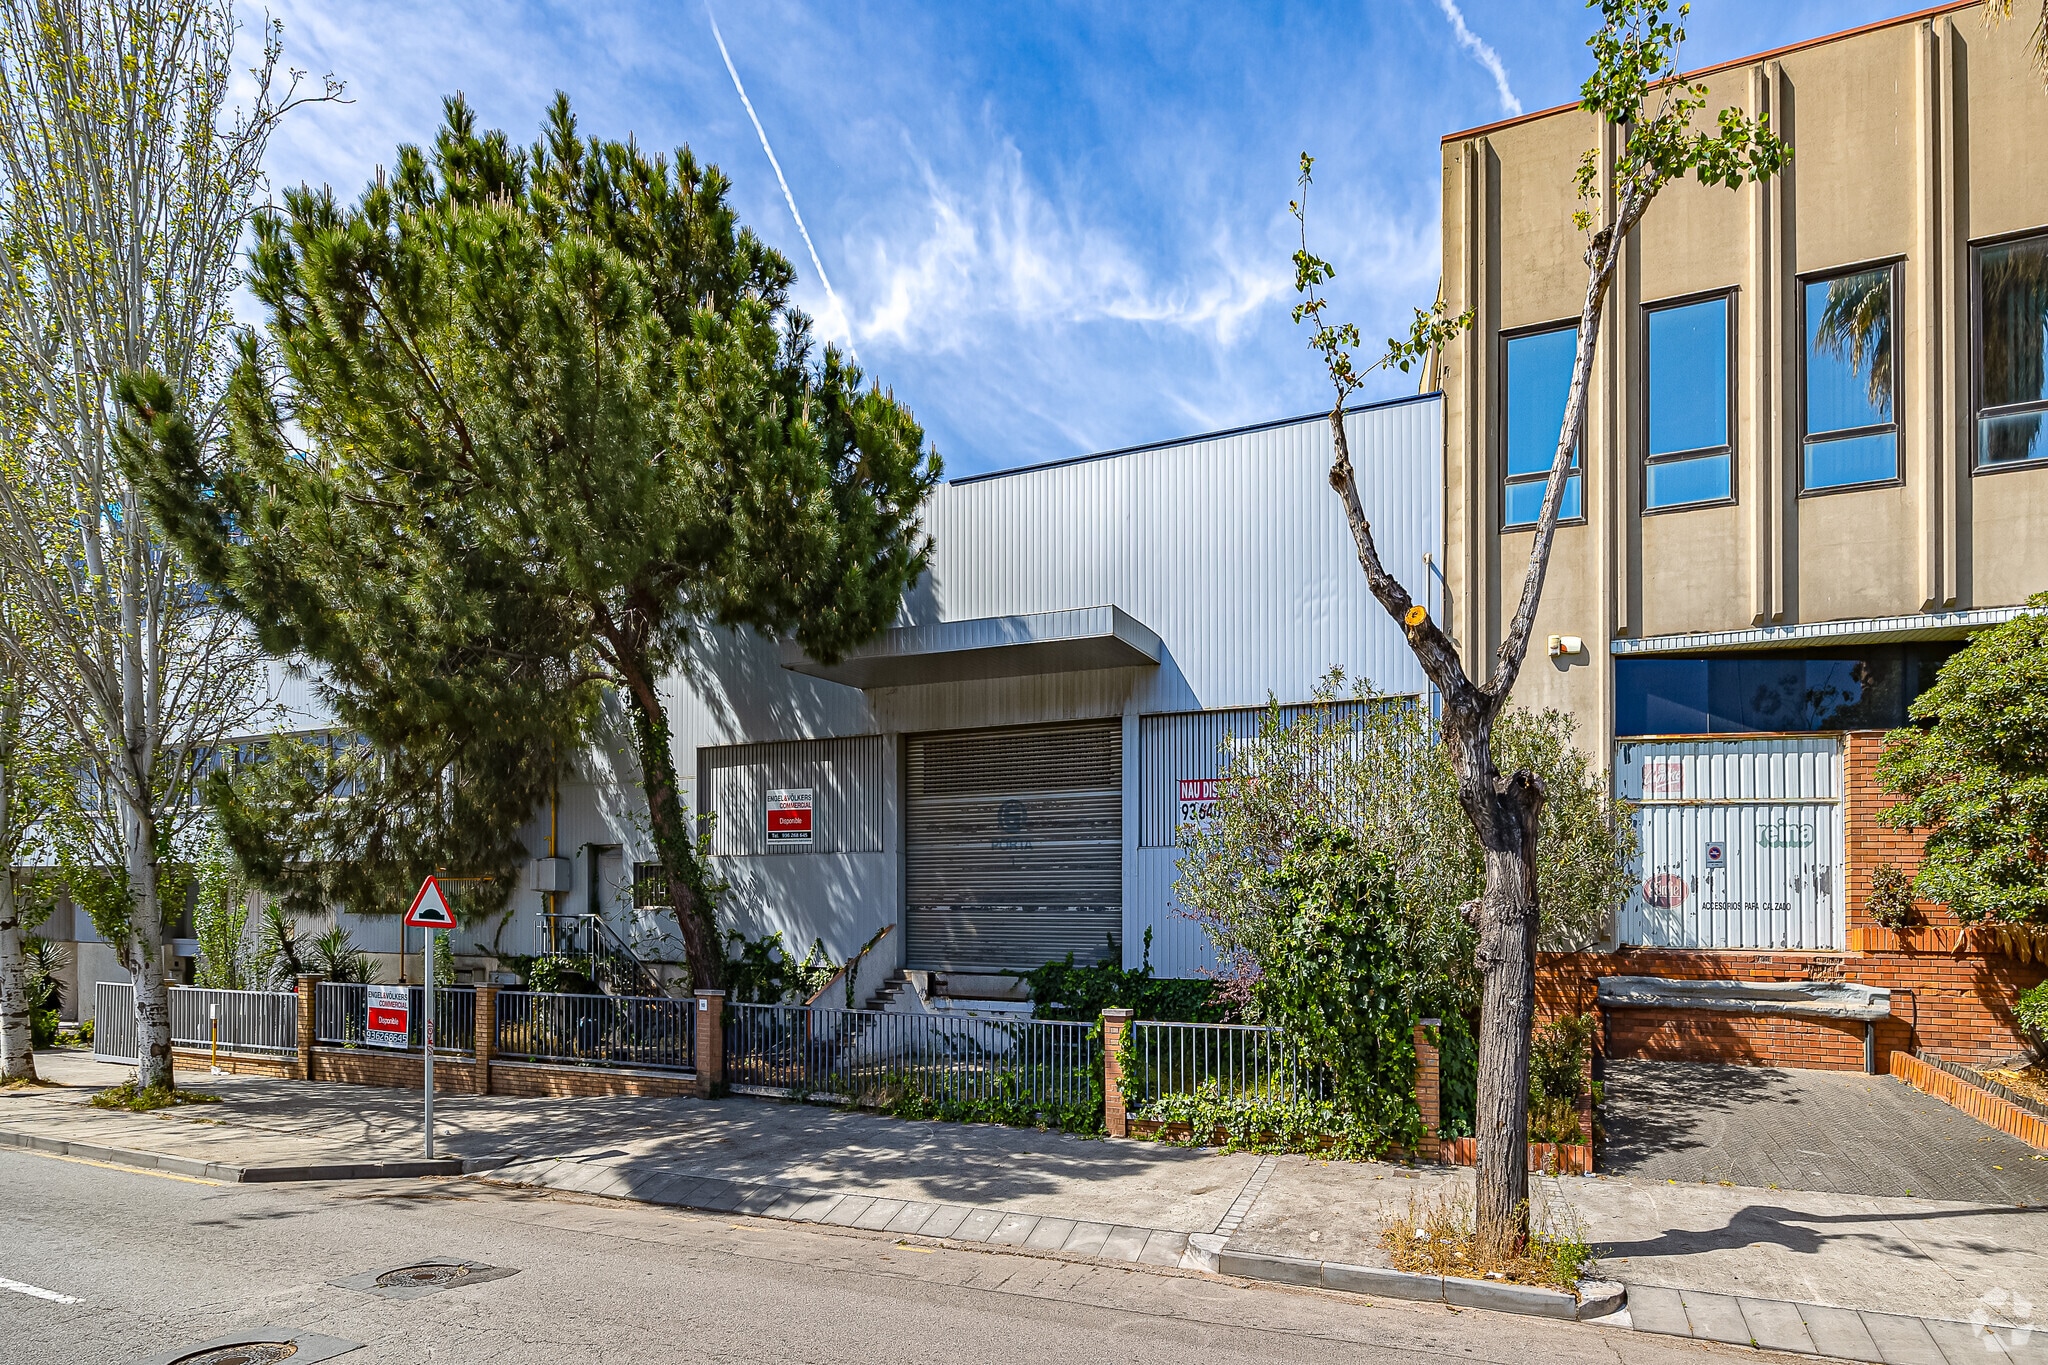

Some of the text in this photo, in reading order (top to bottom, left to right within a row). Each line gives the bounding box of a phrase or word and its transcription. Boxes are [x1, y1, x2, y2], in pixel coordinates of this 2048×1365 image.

[1181, 781, 1200, 799] NAU
[779, 817, 803, 826] Disponible
[1755, 818, 1814, 848] reina
[1701, 902, 1791, 911] ACCESORIOS PARA CALZADO
[378, 1000, 407, 1009] COMMERCIAL
[378, 1016, 399, 1026] Disponible
[366, 1030, 408, 1043] 936268645
